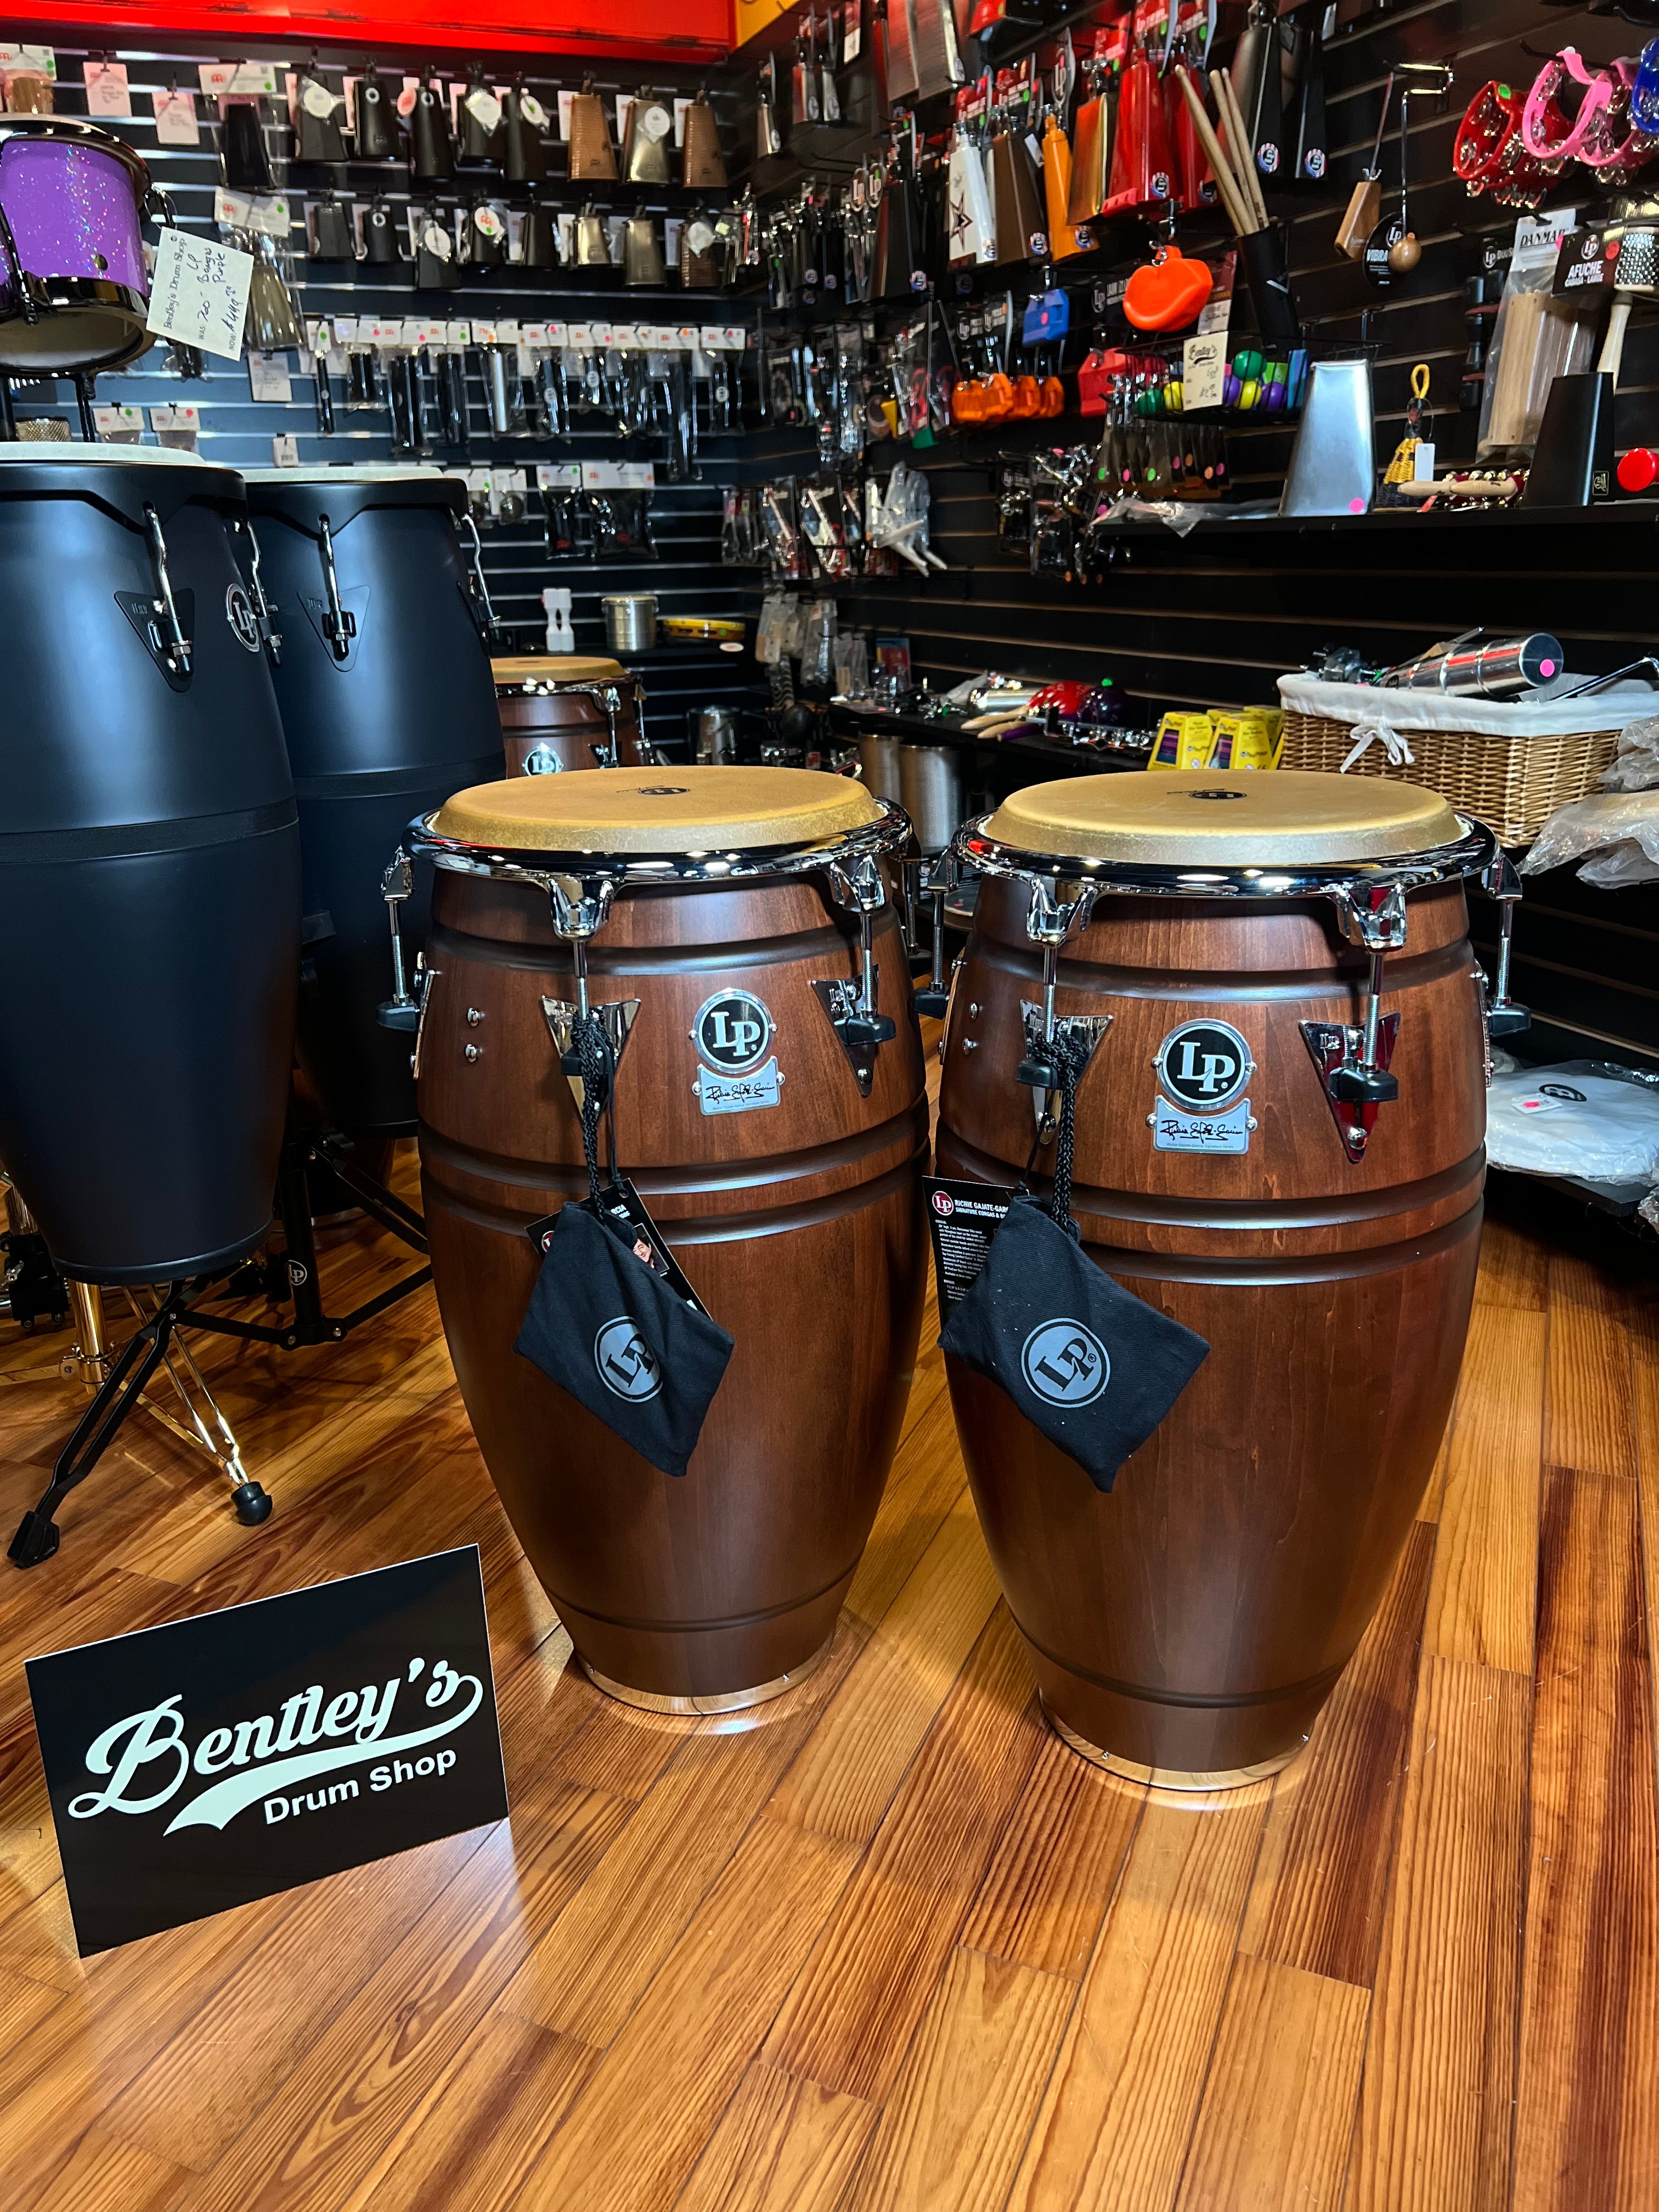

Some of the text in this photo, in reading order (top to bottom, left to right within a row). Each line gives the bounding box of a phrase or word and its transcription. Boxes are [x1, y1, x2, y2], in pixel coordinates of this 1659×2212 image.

[163, 238, 187, 330] Bentley's Drum Shop
[1569, 261, 1604, 278] AFUCHE
[198, 324, 207, 340] WAS:
[228, 332, 238, 350] NOW:
[233, 601, 256, 639] LP
[710, 1012, 761, 1057] LP
[1177, 1041, 1235, 1093] LP
[934, 1195, 952, 1212] LP
[955, 1199, 973, 1208] RICHIE
[955, 1207, 978, 1216] SIGNATURE
[978, 1210, 996, 1218] CONGAS
[606, 1333, 654, 1388] LP
[1034, 1338, 1094, 1392] LP
[67, 1657, 484, 1821] Bentley's
[263, 1750, 456, 1825] Drum Shop
